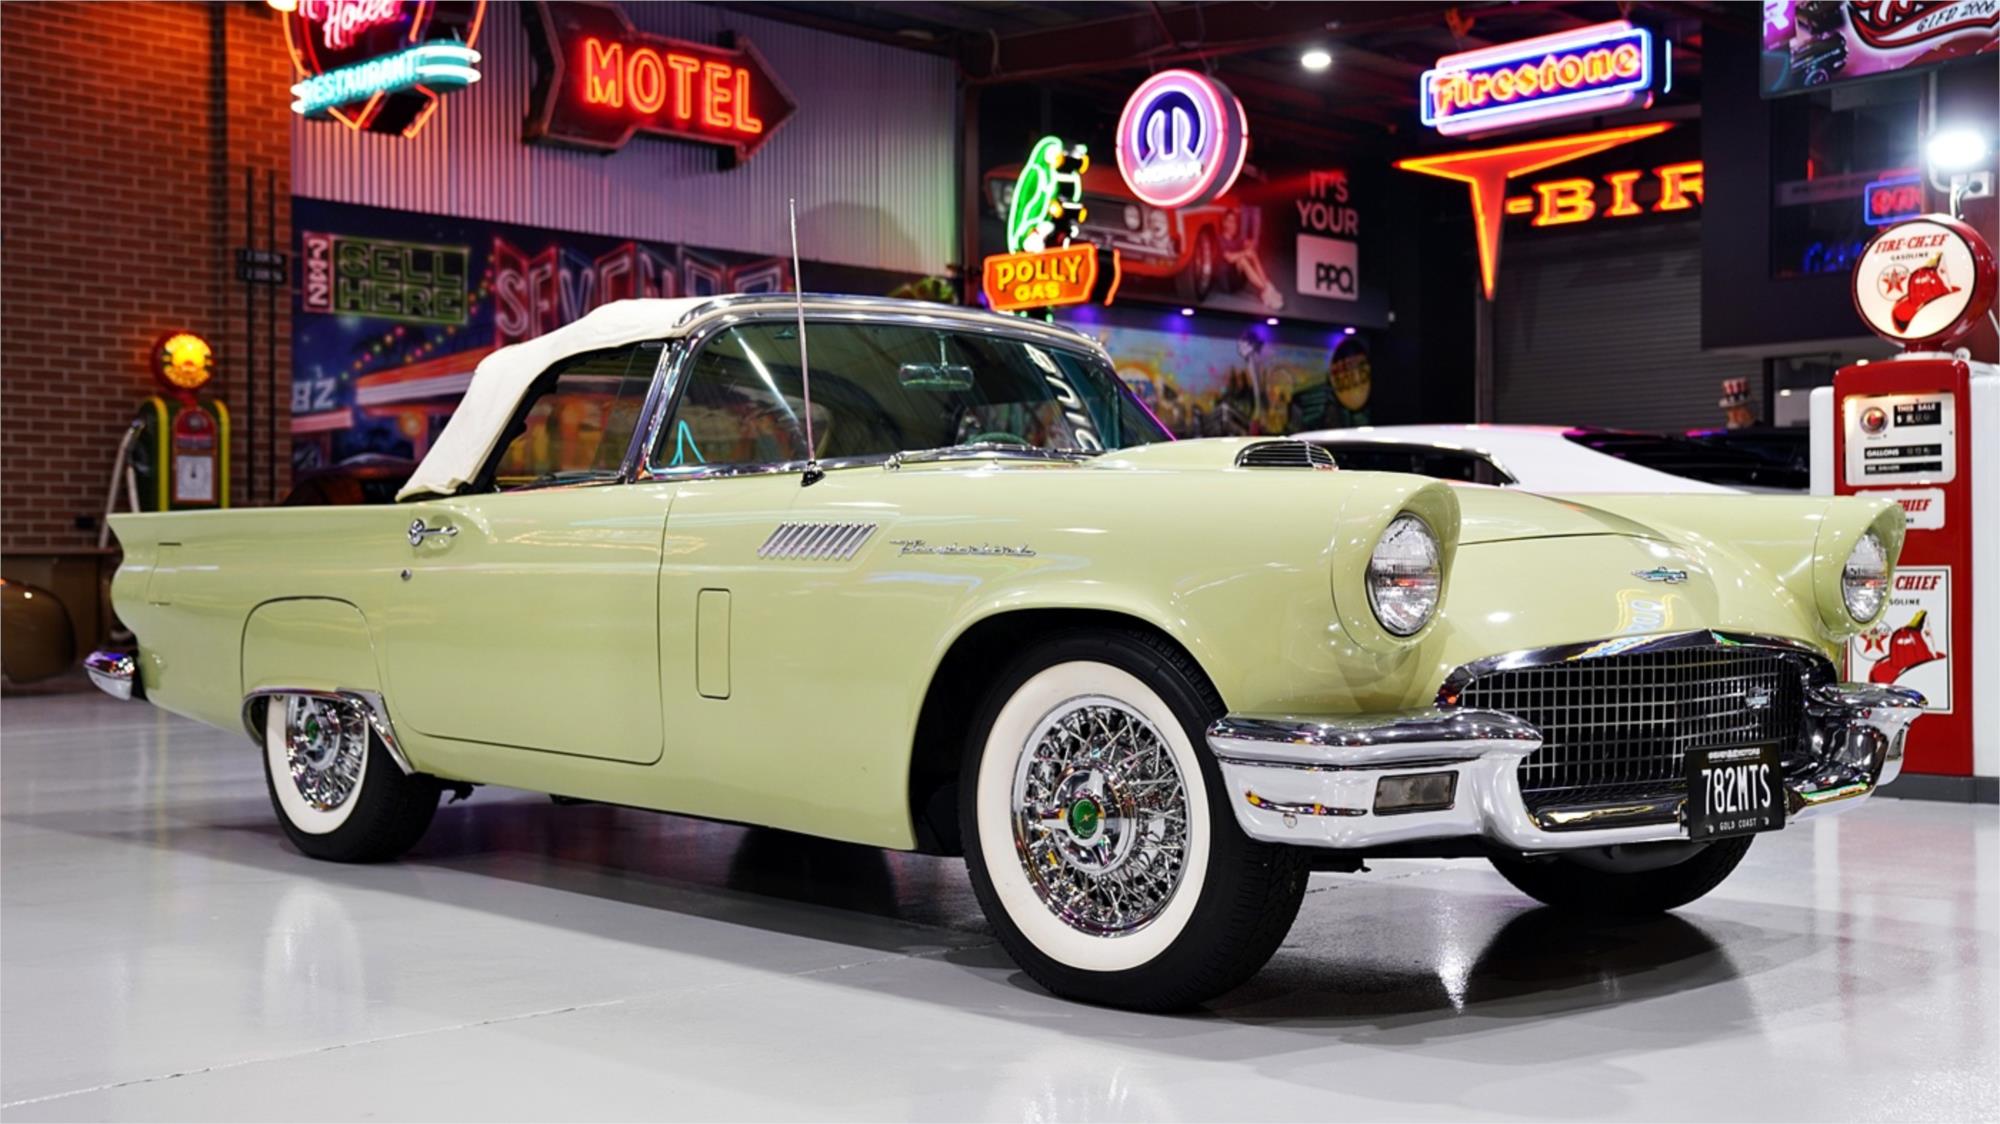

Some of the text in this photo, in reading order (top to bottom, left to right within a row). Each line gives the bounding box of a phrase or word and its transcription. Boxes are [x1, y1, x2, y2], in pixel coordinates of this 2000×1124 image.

[301, 51, 416, 107] RESTAURANT
[584, 38, 763, 135] MOTEL
[1434, 44, 1641, 117] Firestone
[1310, 169, 1348, 202] IT'S
[1296, 199, 1359, 235] YOUR
[338, 242, 462, 286] SELL
[996, 254, 1082, 291] POLLY
[1890, 251, 1929, 262] GASOLINE
[1014, 280, 1060, 301] GAS
[1315, 262, 1354, 294] PPQ
[338, 278, 462, 321] HERE
[1866, 448, 1900, 457] GALLONS
[1895, 575, 1942, 591] CHIEF
[1889, 598, 1920, 606] SOLINE
[1701, 763, 1772, 816] 782MTS
[1719, 817, 1757, 831] GOLD COAST
